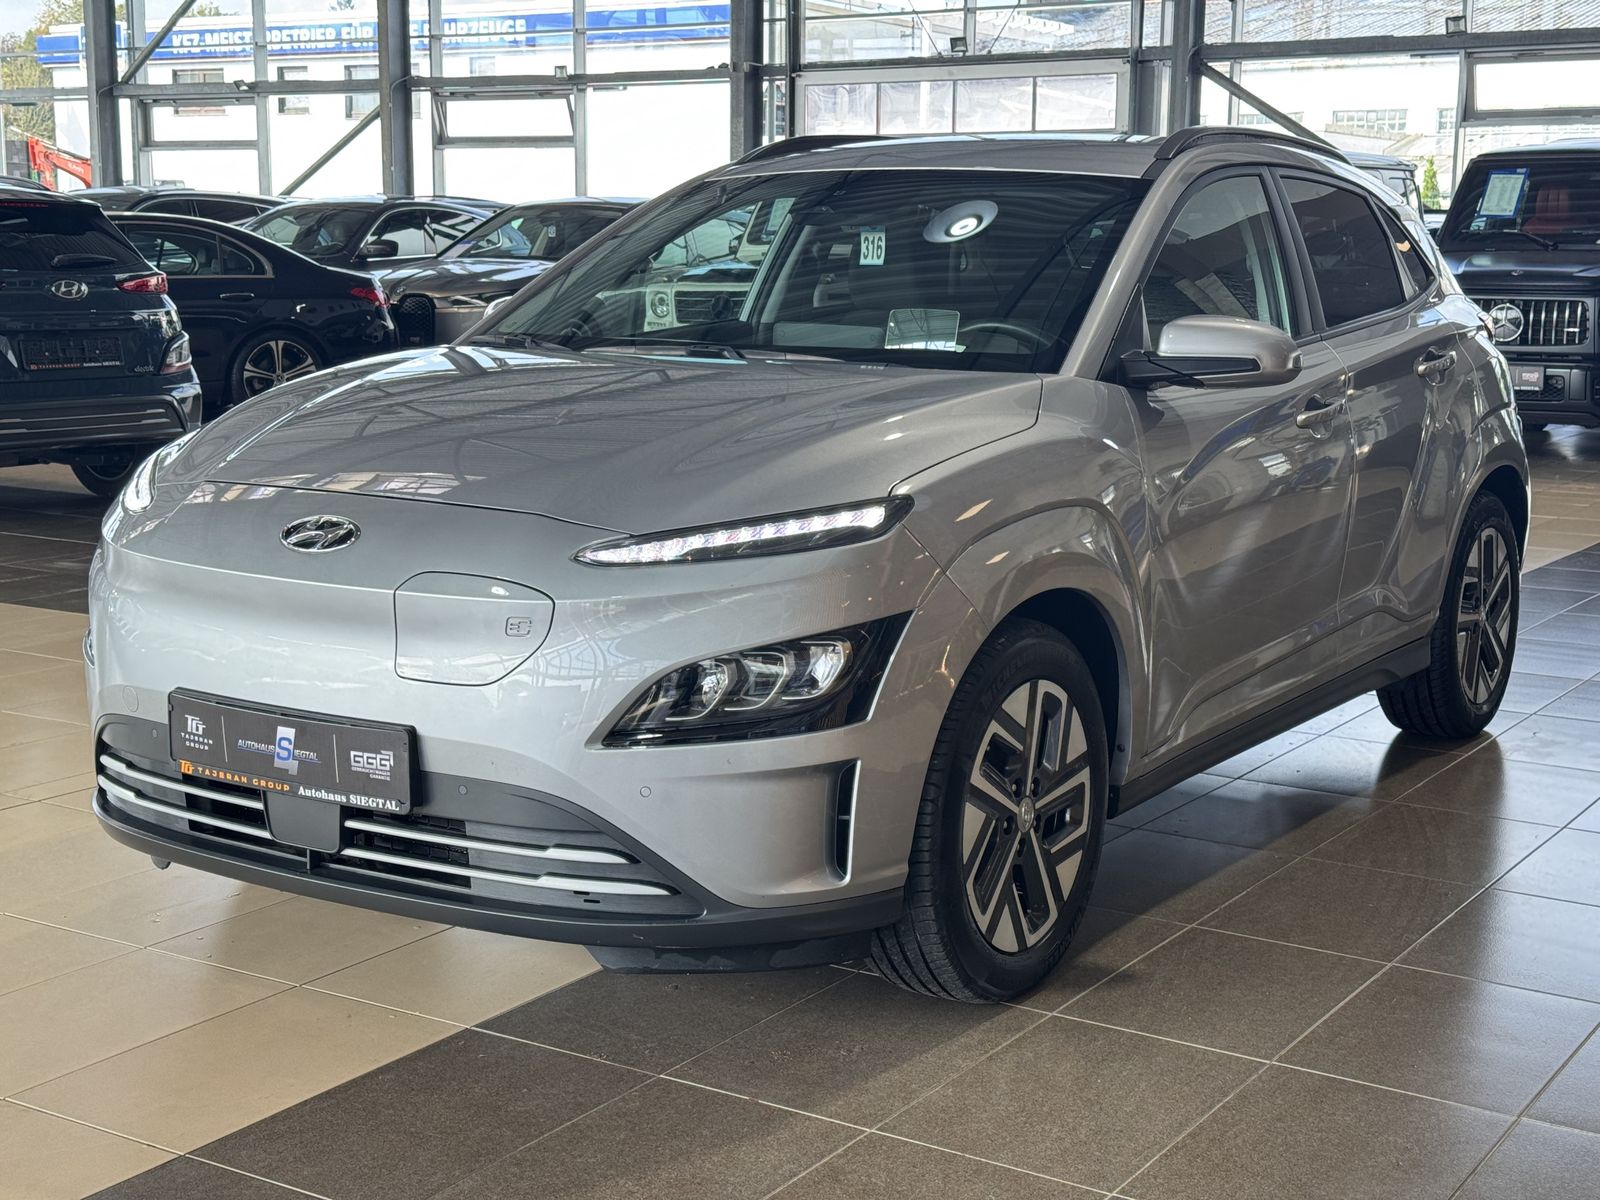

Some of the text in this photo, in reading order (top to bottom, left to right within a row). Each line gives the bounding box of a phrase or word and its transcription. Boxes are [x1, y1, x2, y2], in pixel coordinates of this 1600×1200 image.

[422, 19, 527, 45] FHRZEUGE
[863, 235, 883, 260] 316
[237, 739, 276, 753] AUTOHAUS
[252, 778, 290, 791] GROUP
[298, 785, 347, 802] Autohaus
[349, 794, 400, 811] SIEGTAL
